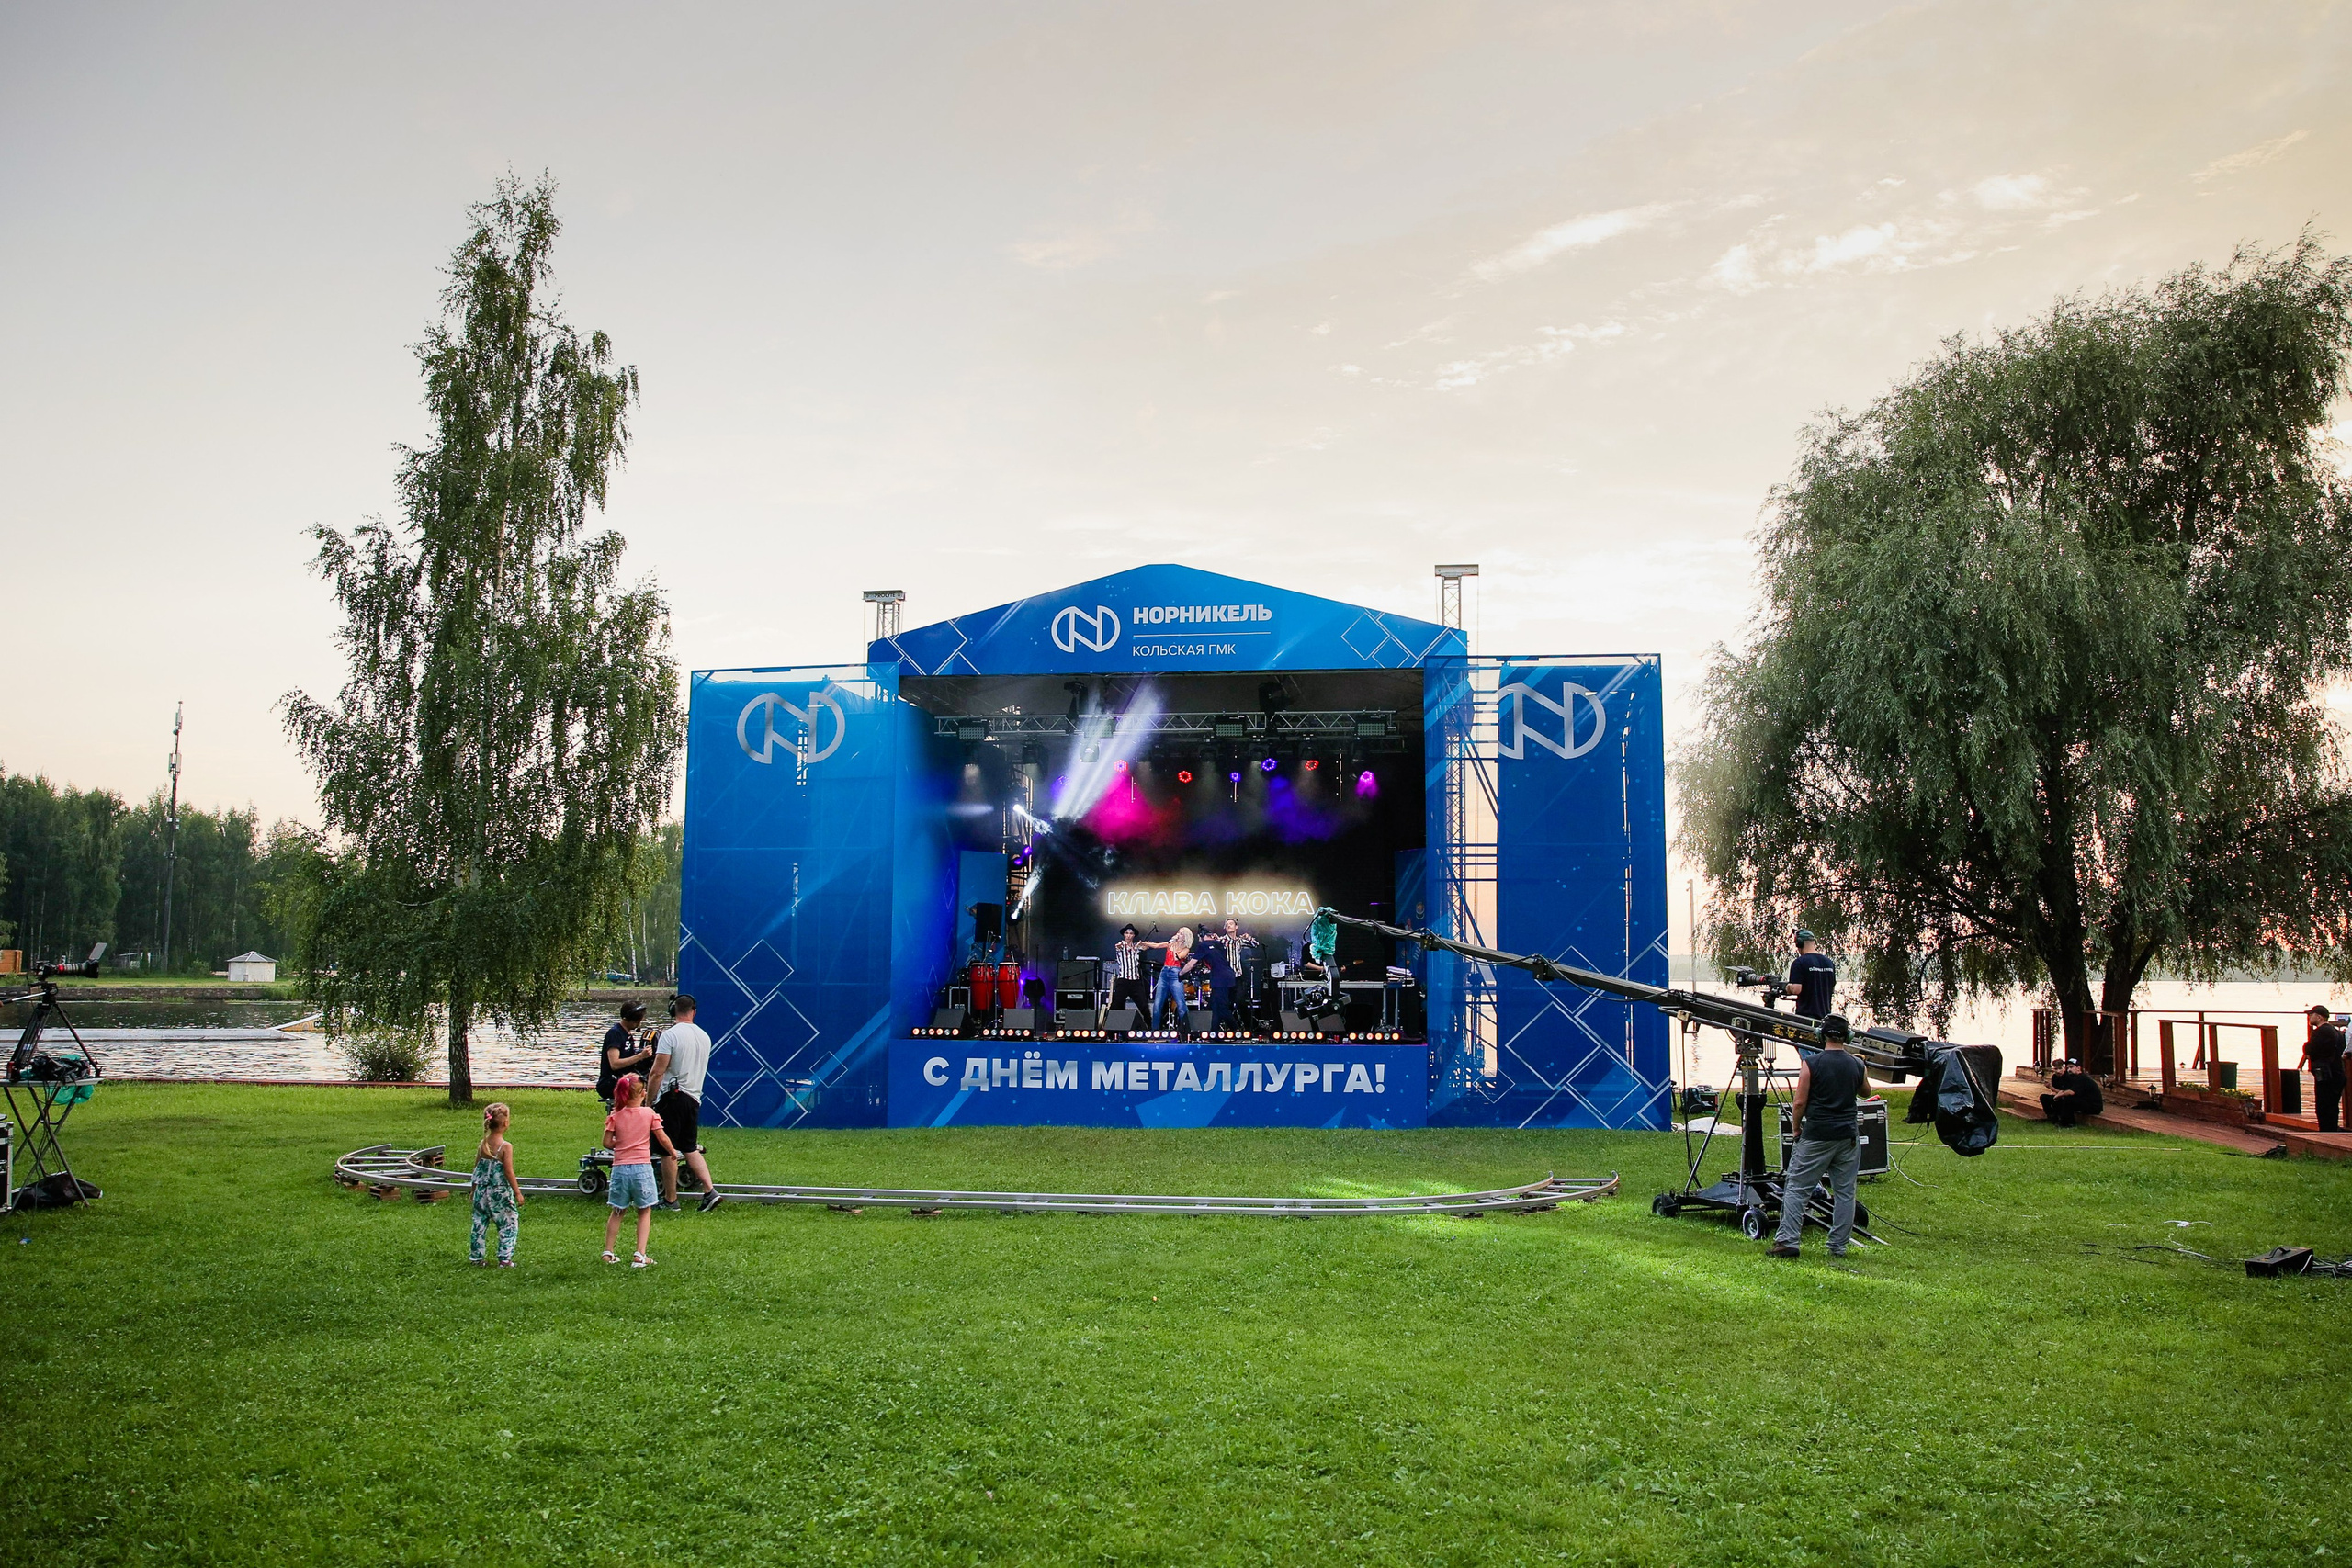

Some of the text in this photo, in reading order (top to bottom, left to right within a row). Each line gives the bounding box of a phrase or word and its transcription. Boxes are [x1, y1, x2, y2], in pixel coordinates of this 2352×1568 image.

[1133, 604, 1272, 625] НОРНИКЕЛЬ
[1132, 644, 1237, 657] КОЛЬСКАЯ ГМК
[1107, 891, 1315, 915] КЛАВА КОКА
[923, 1051, 1385, 1094] С ДНЁМ МЕТАЛЛУРГА!
